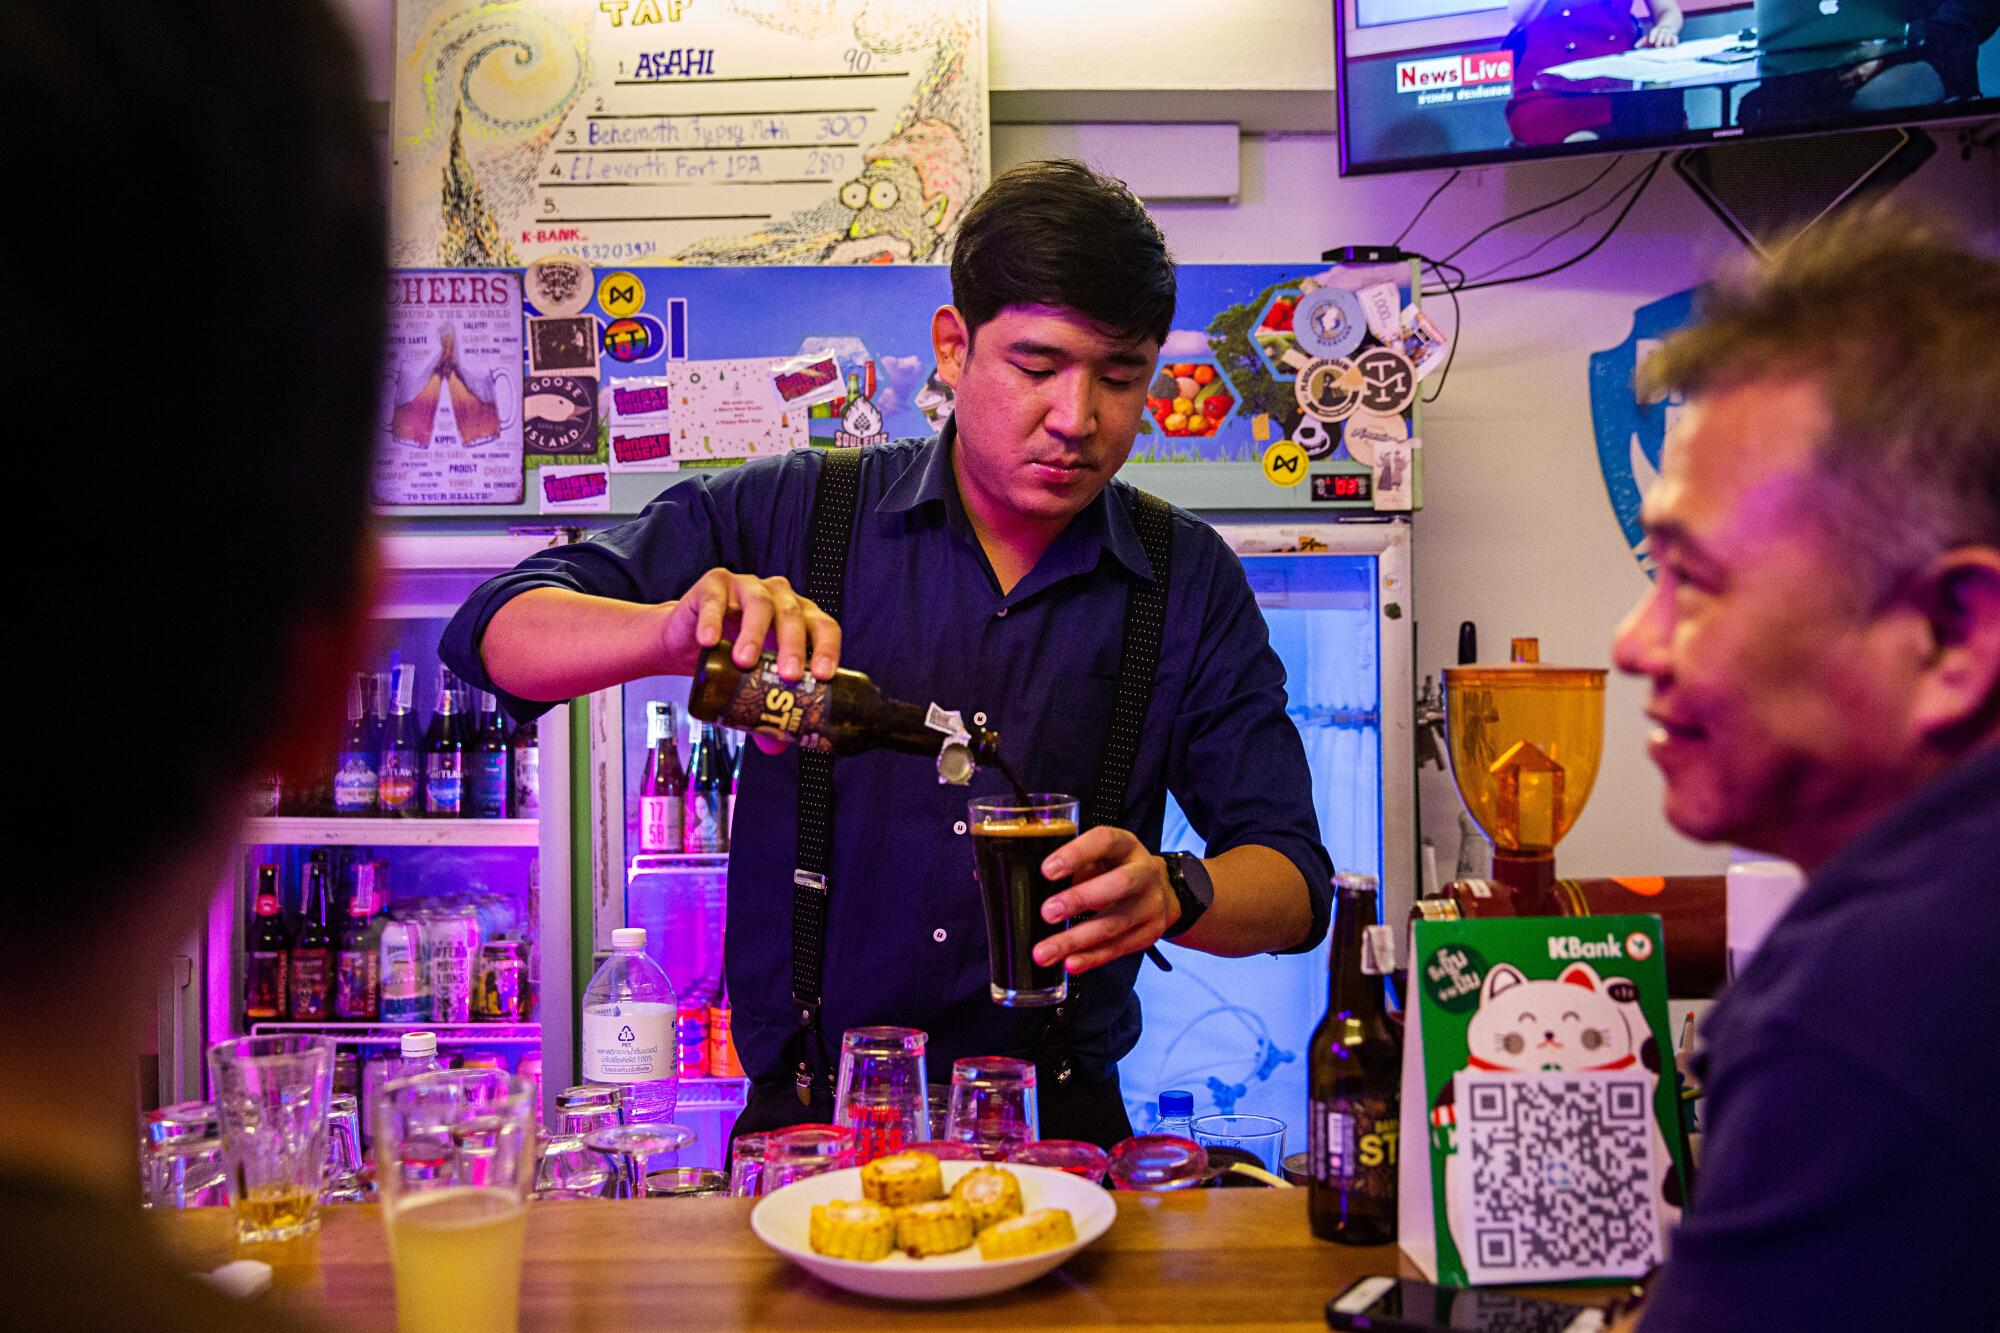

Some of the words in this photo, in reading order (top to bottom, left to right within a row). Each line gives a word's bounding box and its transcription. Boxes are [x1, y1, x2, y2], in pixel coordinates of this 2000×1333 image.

[600, 0, 692, 27] TAP
[634, 48, 715, 79] ASAHI
[1401, 66, 1458, 88] News
[1463, 57, 1511, 82] Live
[816, 115, 868, 141] 300
[724, 156, 762, 178] IPA
[543, 197, 560, 214] 5.
[531, 377, 582, 398] GOOSE
[524, 426, 578, 447] ISLAND
[649, 802, 663, 821] 17
[1548, 933, 1622, 959] KBank
